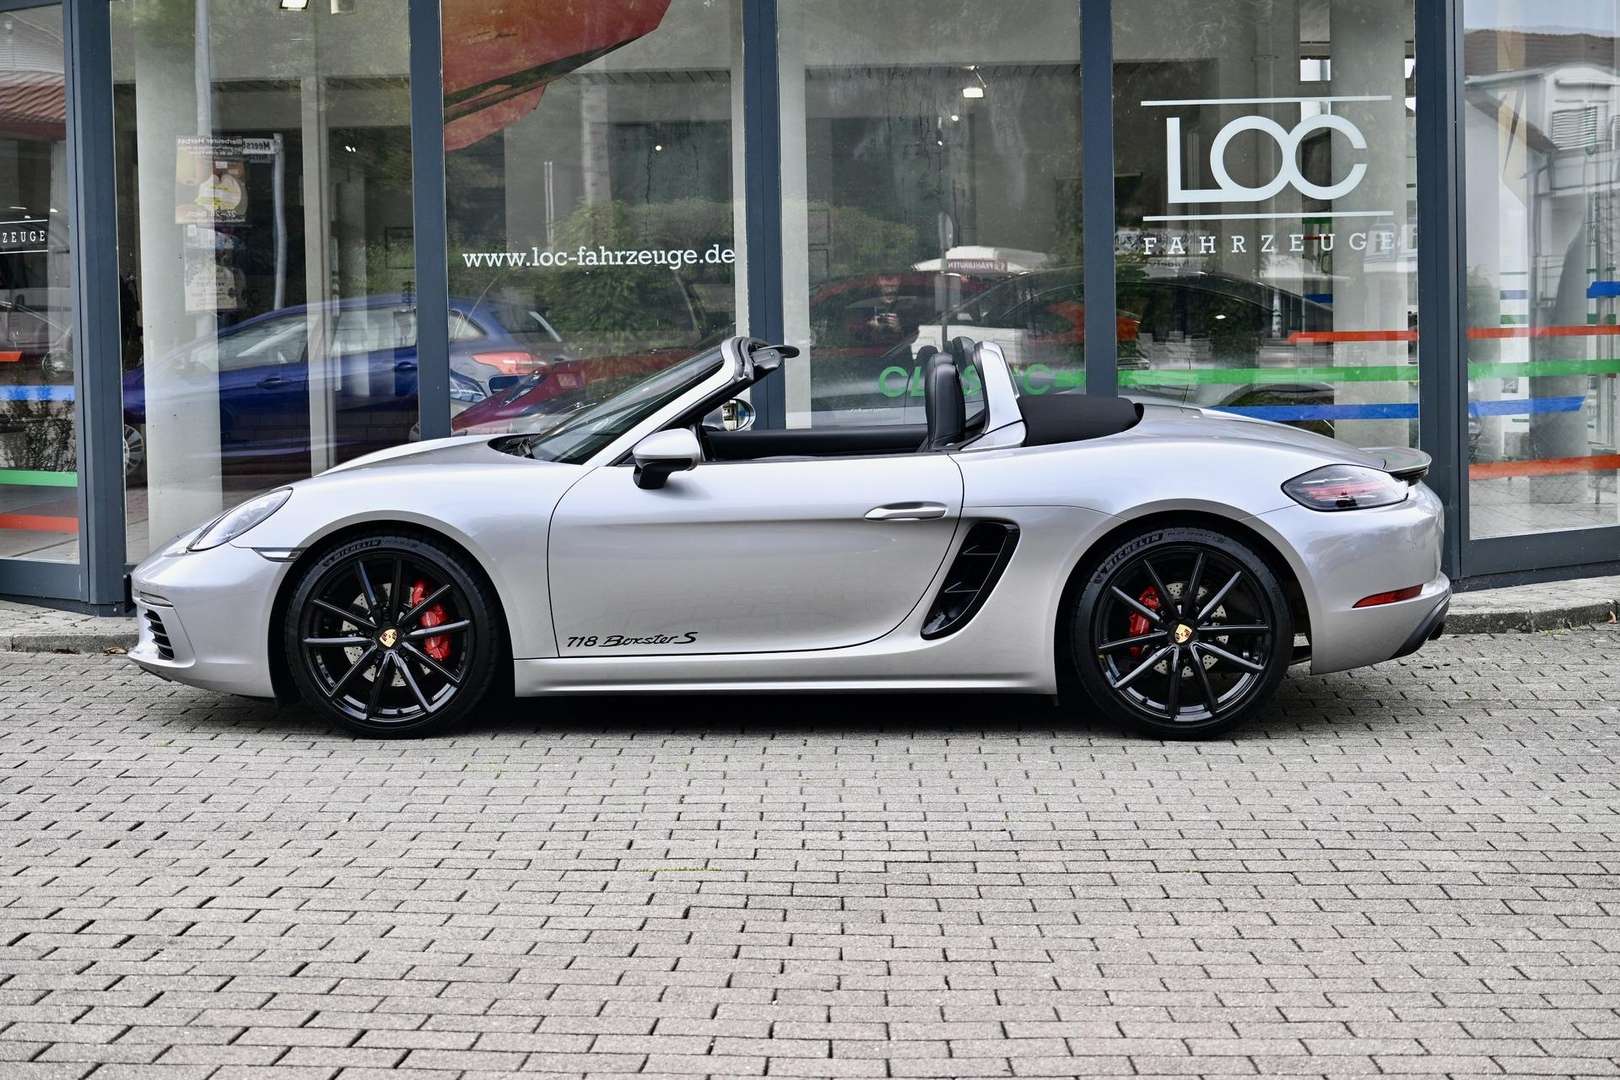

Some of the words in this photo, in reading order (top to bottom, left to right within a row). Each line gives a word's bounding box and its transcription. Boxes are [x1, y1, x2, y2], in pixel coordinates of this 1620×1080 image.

[1166, 114, 1368, 204] LOC
[462, 244, 735, 269] www.loc-fahrzeuge.de
[1143, 233, 1395, 256] FAHRZEUGE
[567, 635, 598, 648] 718
[598, 633, 679, 648] Boxster
[673, 631, 699, 645] S
